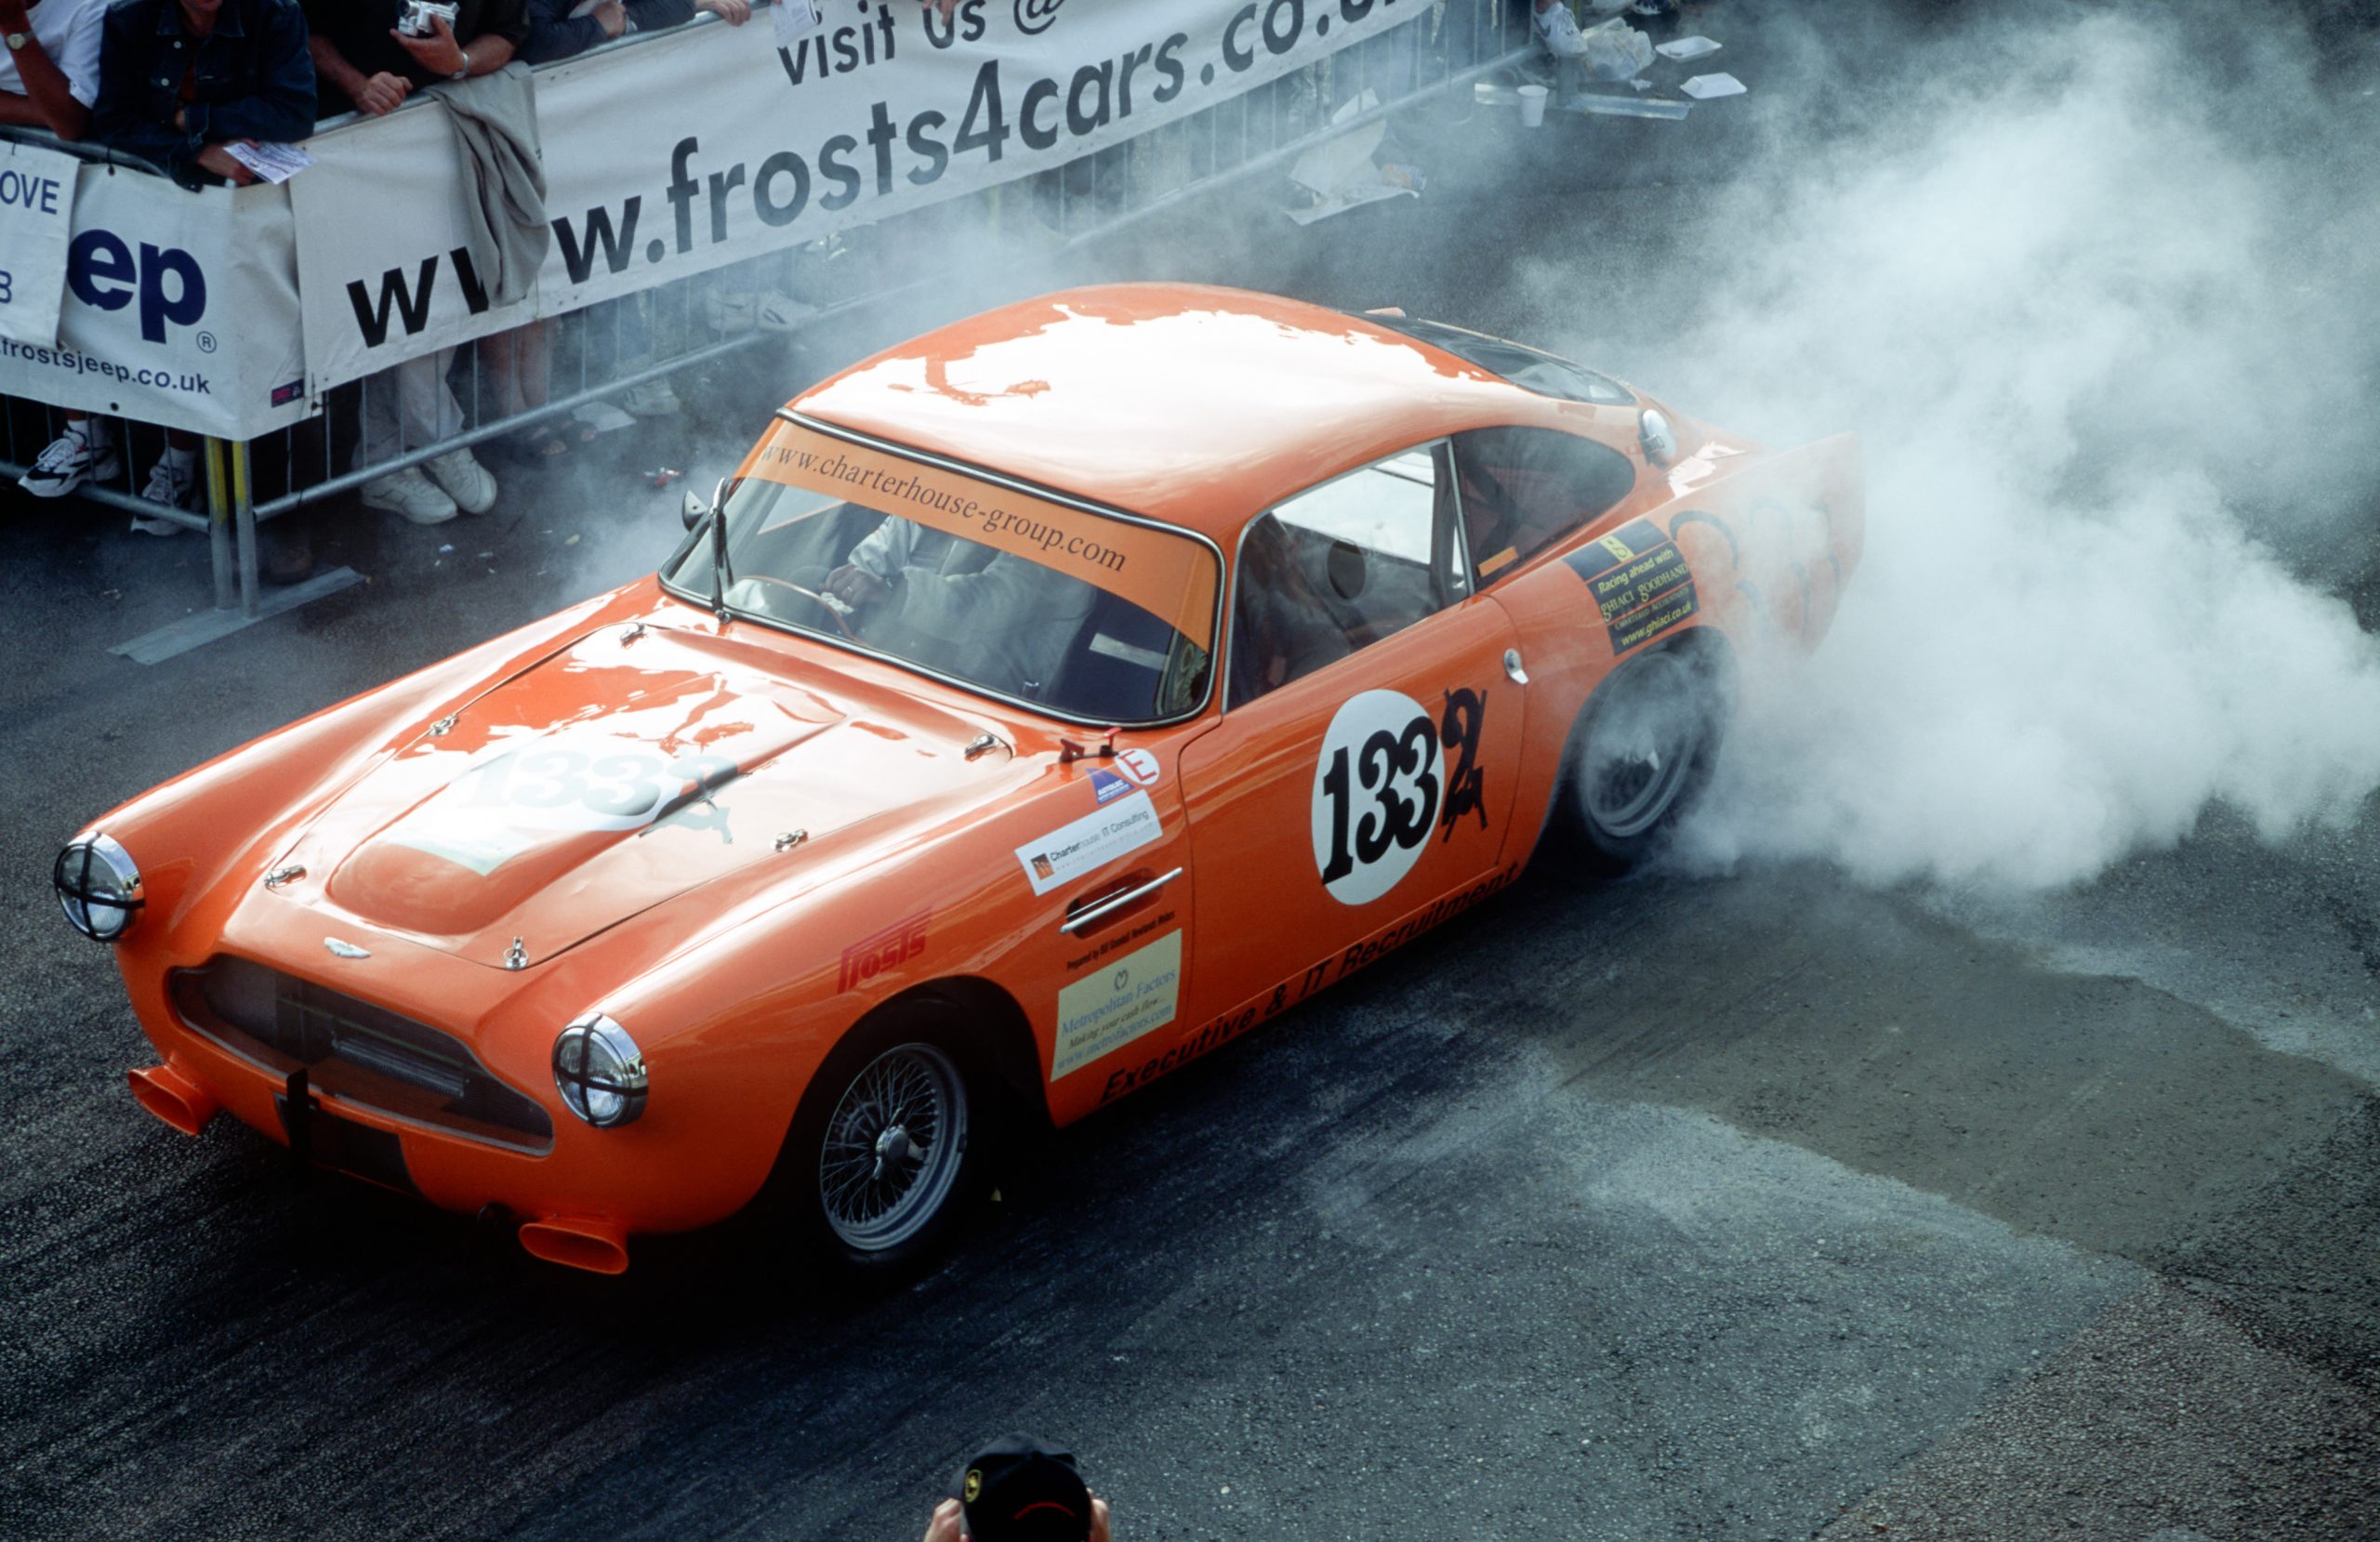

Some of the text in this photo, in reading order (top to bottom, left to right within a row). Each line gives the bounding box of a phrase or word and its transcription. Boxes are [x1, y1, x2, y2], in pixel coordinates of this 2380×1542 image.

[778, 0, 894, 86] visit
[922, 0, 985, 49] us
[0, 170, 60, 215] OVE
[66, 229, 206, 345] ep
[761, 445, 1127, 573] www.charterhouse-group.com
[1598, 548, 1674, 594] Racing ahead with
[1621, 600, 1692, 646] www.ghiaci.co.uk
[1117, 750, 1157, 782] E
[1101, 826, 1110, 838] IT
[1111, 811, 1150, 833] Consulting
[1062, 971, 1176, 1036] Metropolitan Factors
[1101, 862, 1519, 1103] Executive & IT Recruitment
